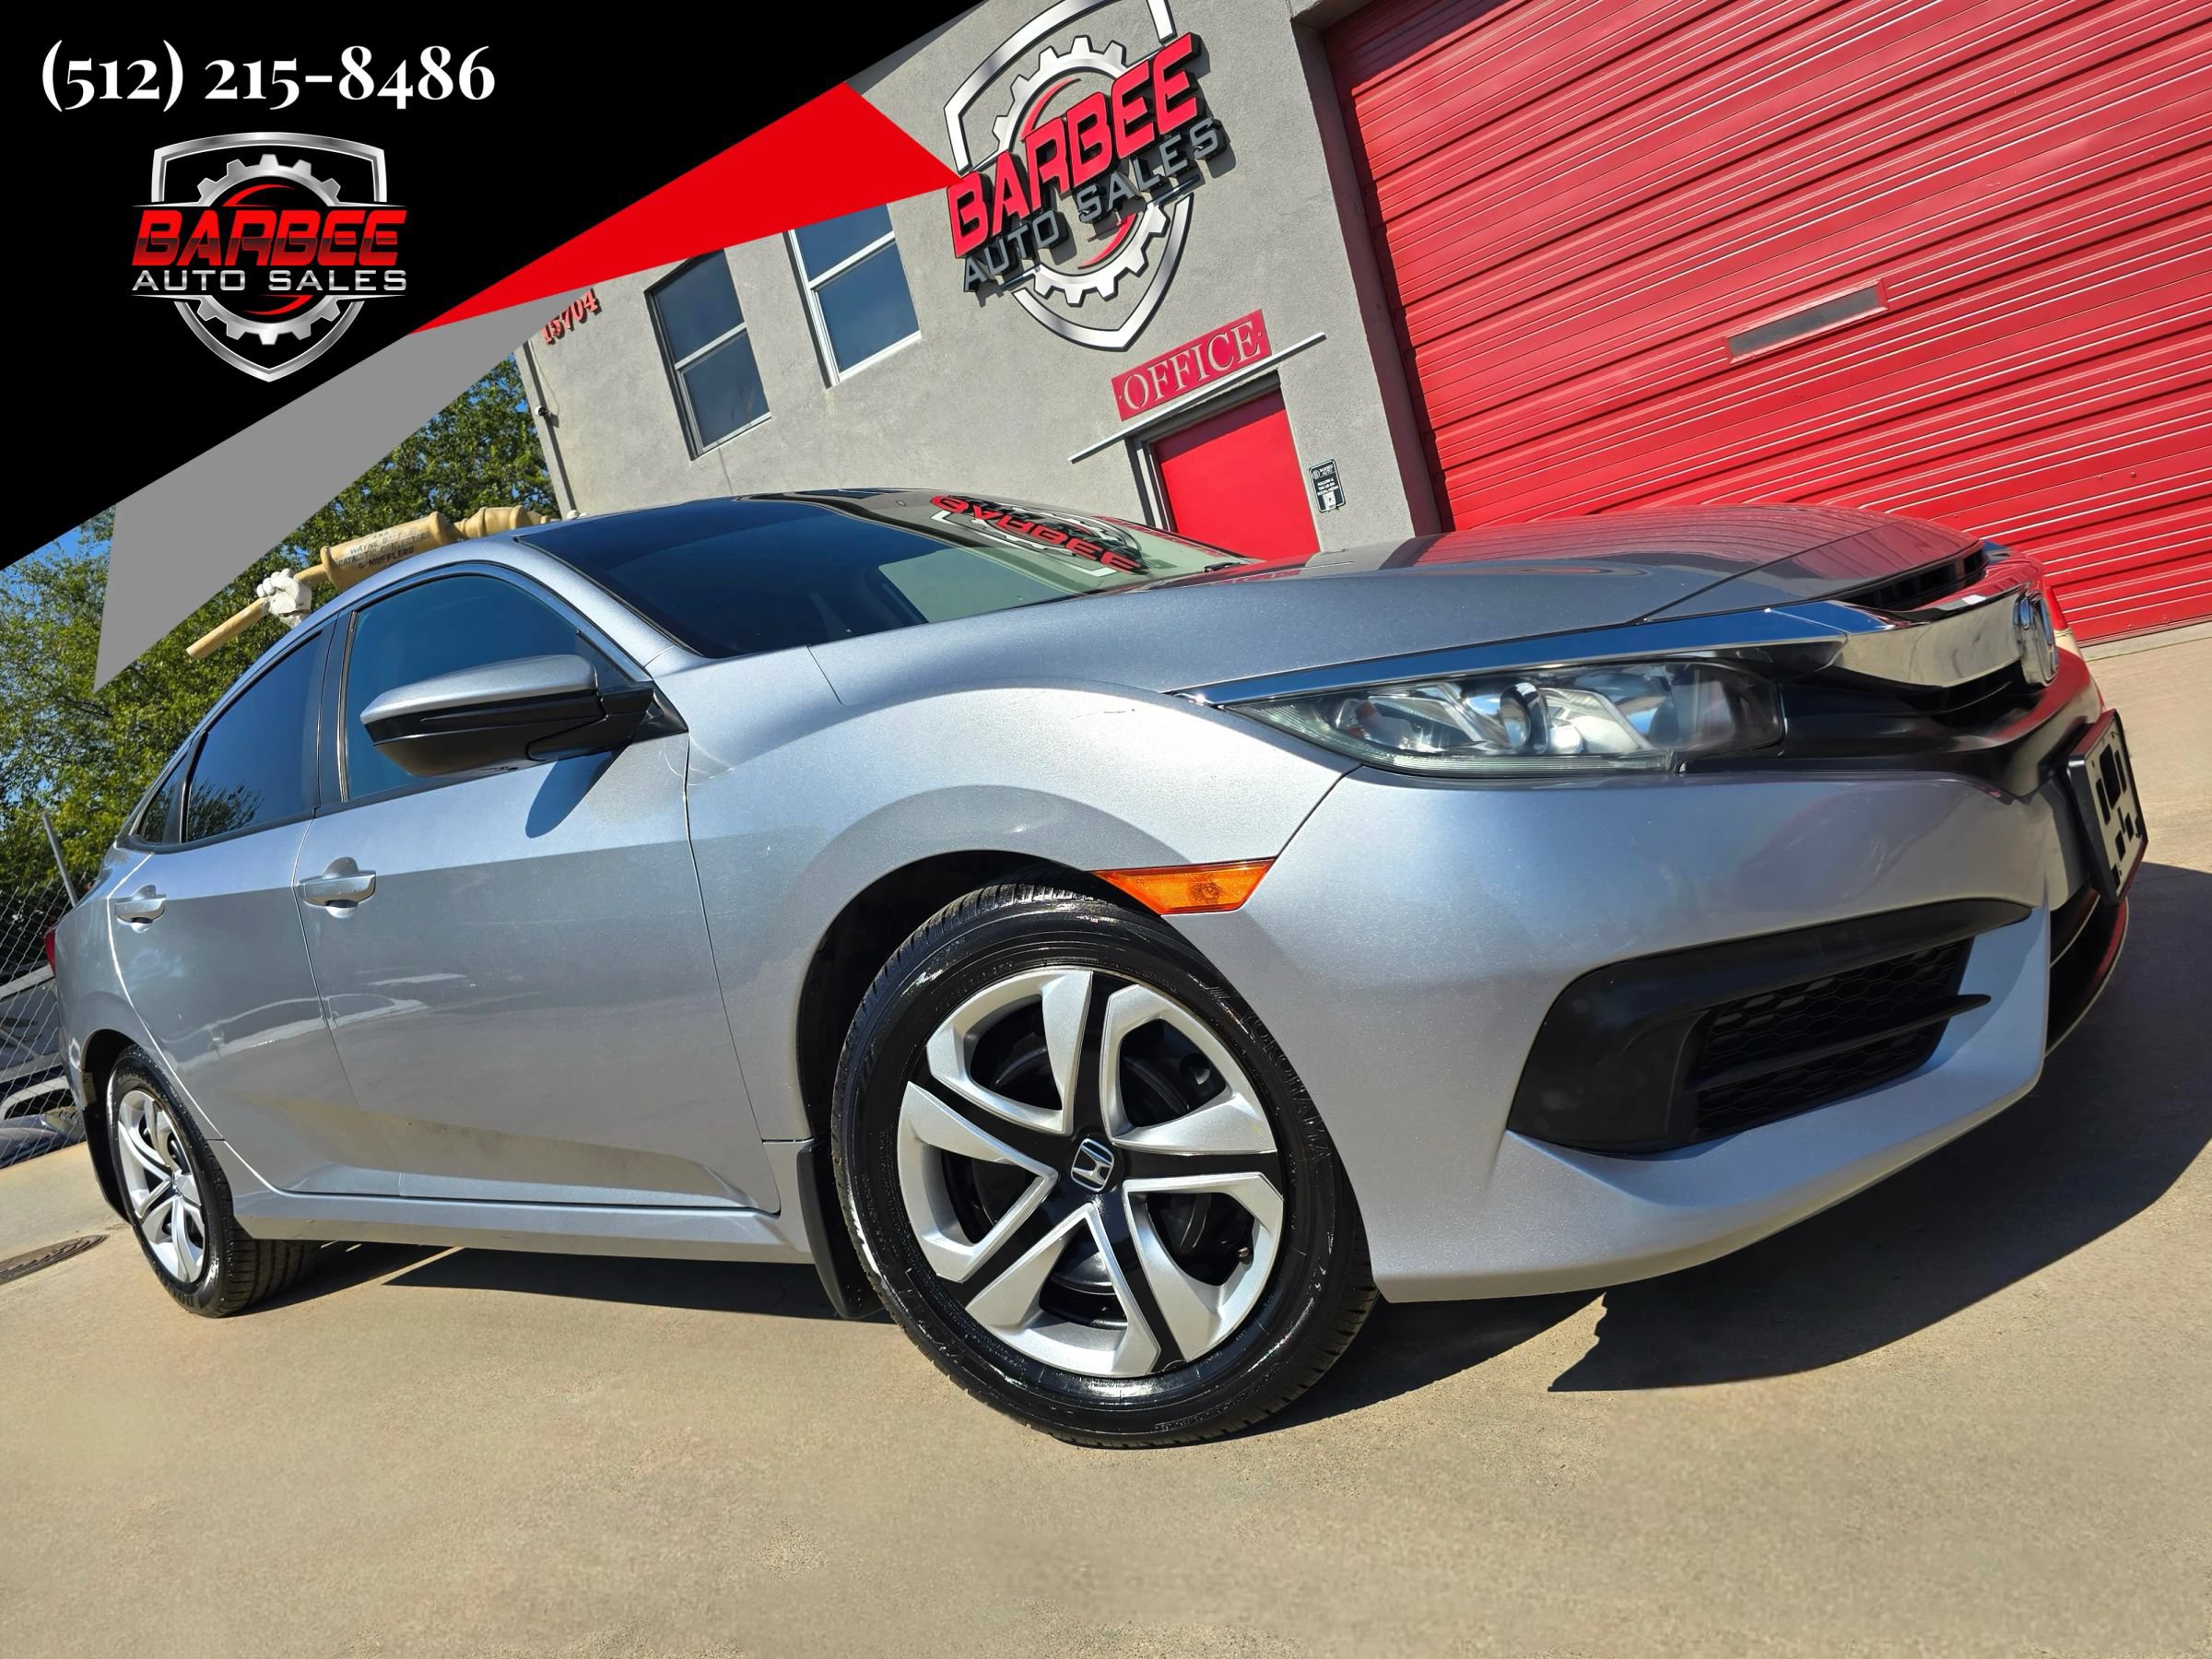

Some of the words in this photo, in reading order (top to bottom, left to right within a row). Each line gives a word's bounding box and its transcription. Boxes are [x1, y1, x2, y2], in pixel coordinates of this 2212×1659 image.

[947, 32, 1195, 258] BARBEE
[964, 209, 1061, 291] AUTO
[1077, 117, 1219, 223] SALES
[541, 289, 600, 344] 15704
[1122, 320, 1261, 411] OFFICE
[369, 546, 415, 566] MUFFLERS
